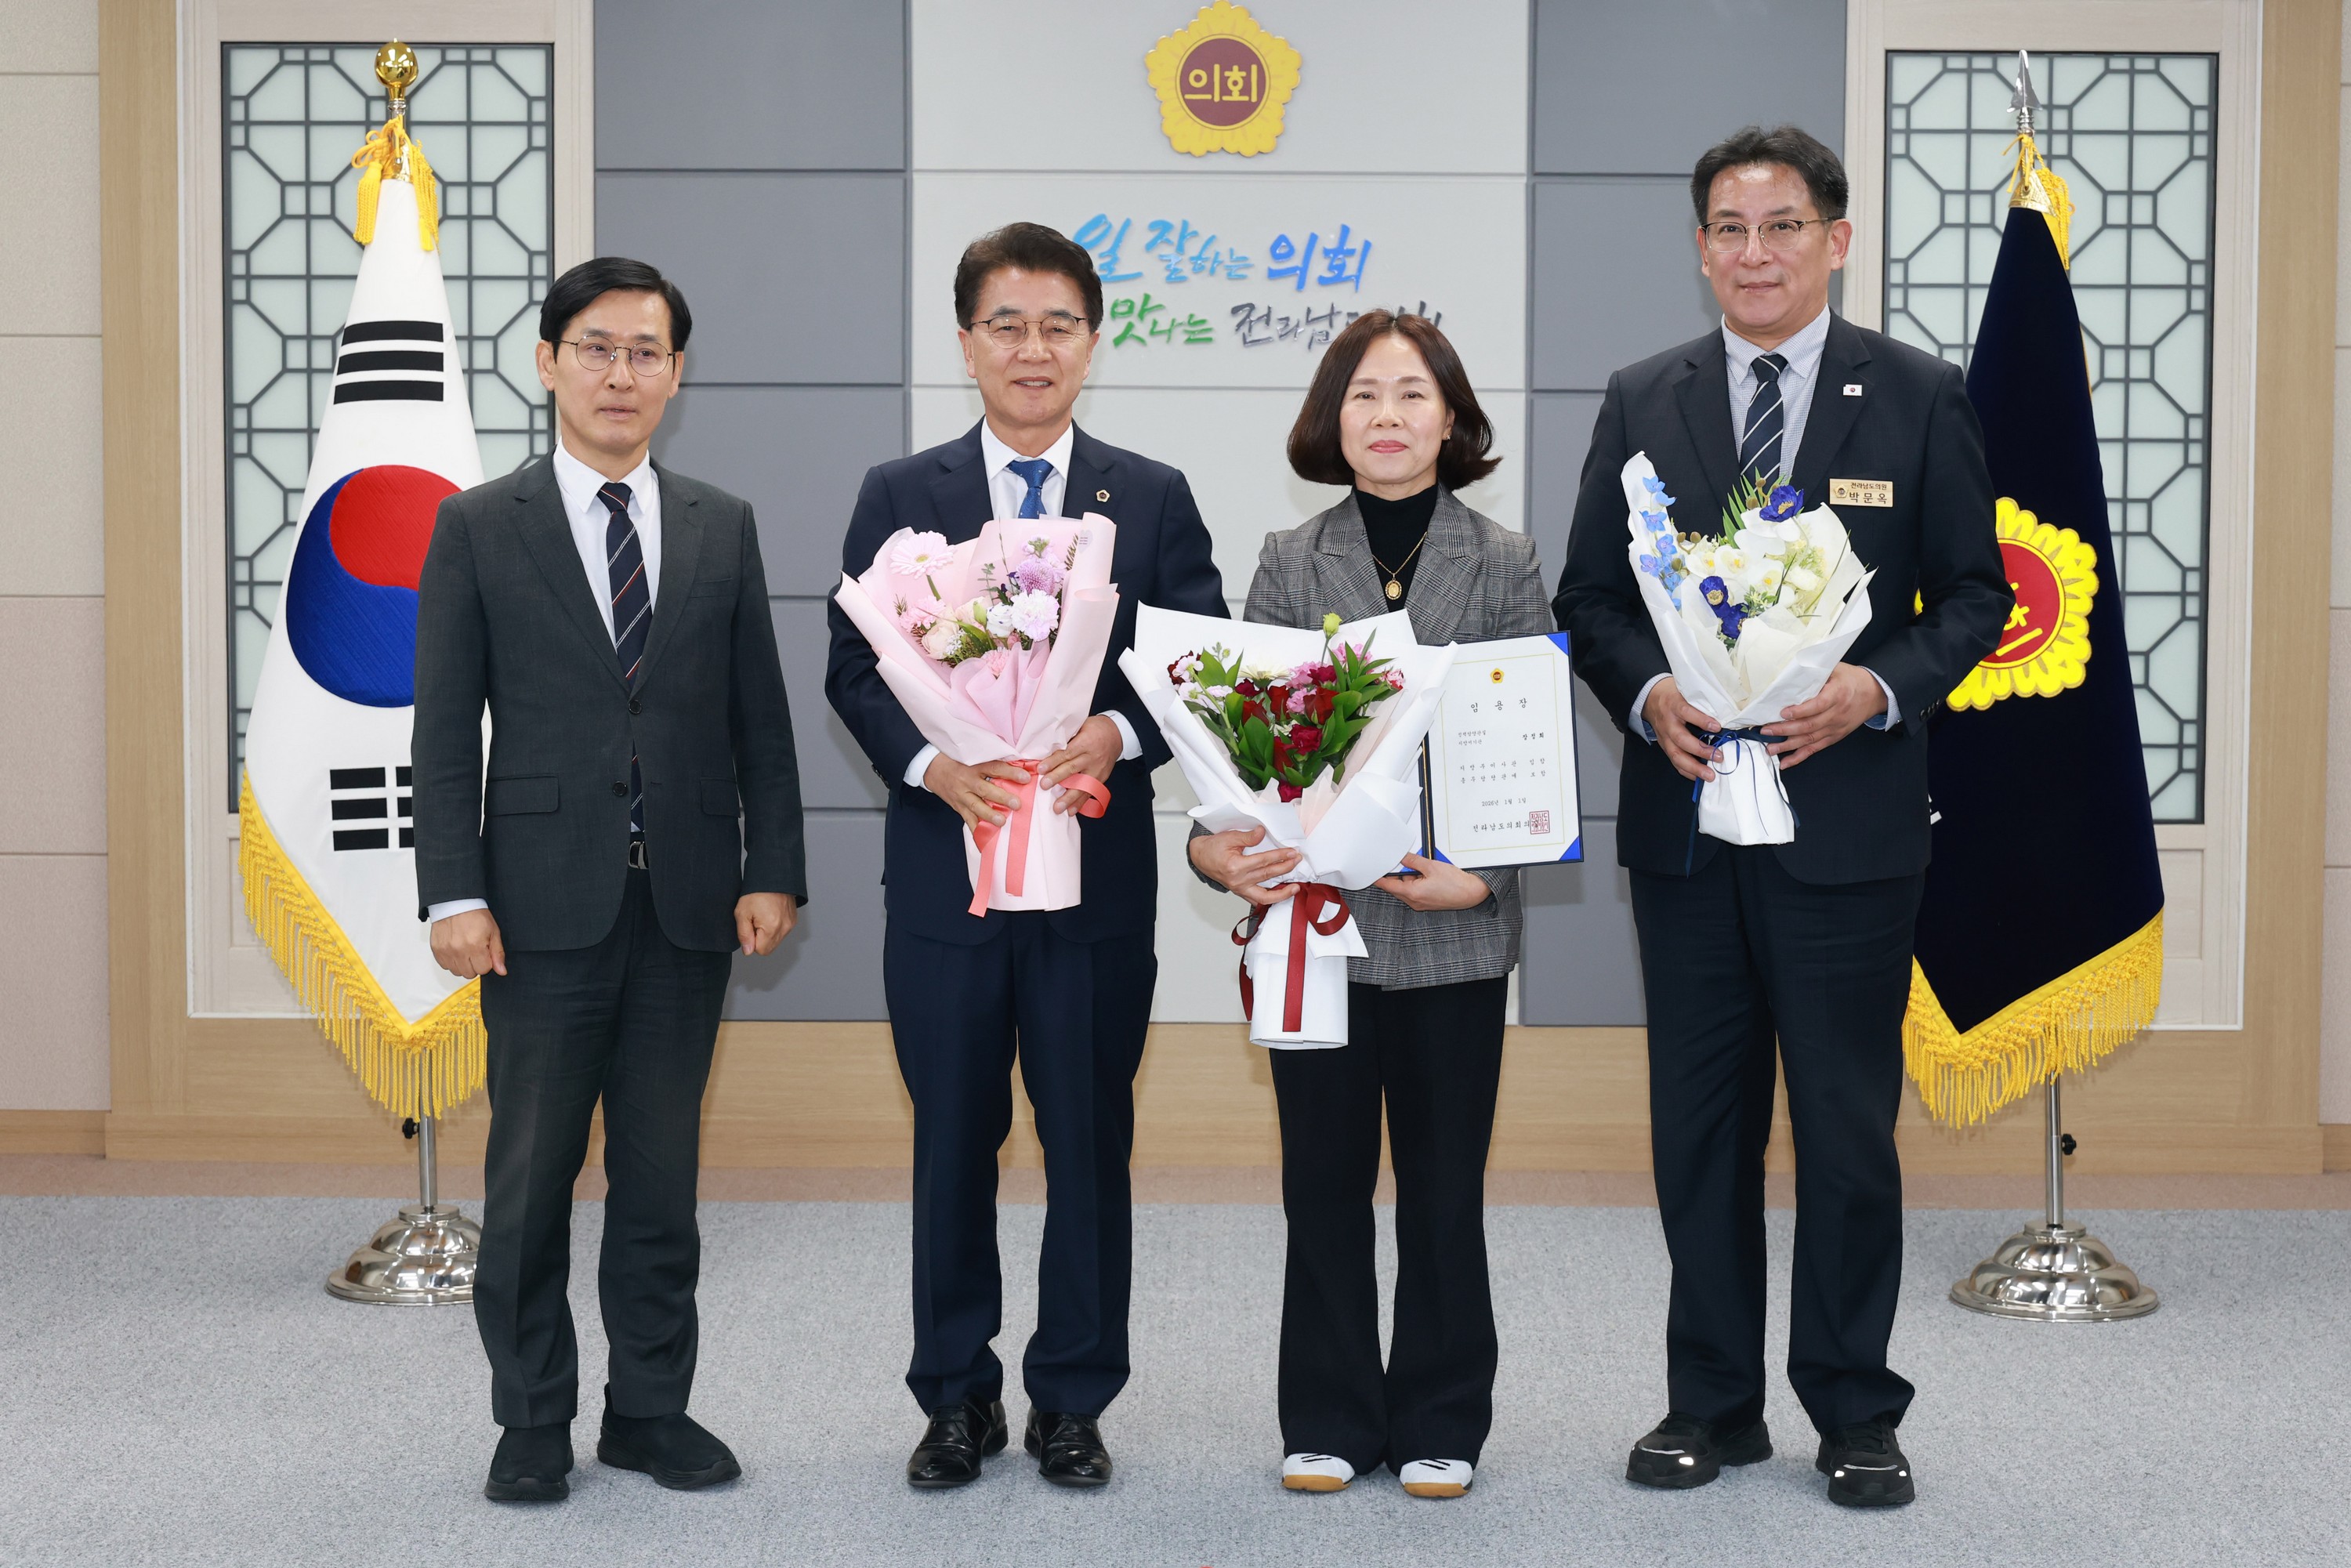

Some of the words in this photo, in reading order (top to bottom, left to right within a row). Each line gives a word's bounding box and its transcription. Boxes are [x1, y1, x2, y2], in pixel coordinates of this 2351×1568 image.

[1184, 63, 1258, 103] 의회
[1073, 213, 1143, 283] 일
[1145, 219, 1255, 284] 잘하는
[1267, 223, 1372, 293] 의회
[1110, 293, 1213, 348] 맛나는
[1850, 482, 1887, 491] 전라남도의원
